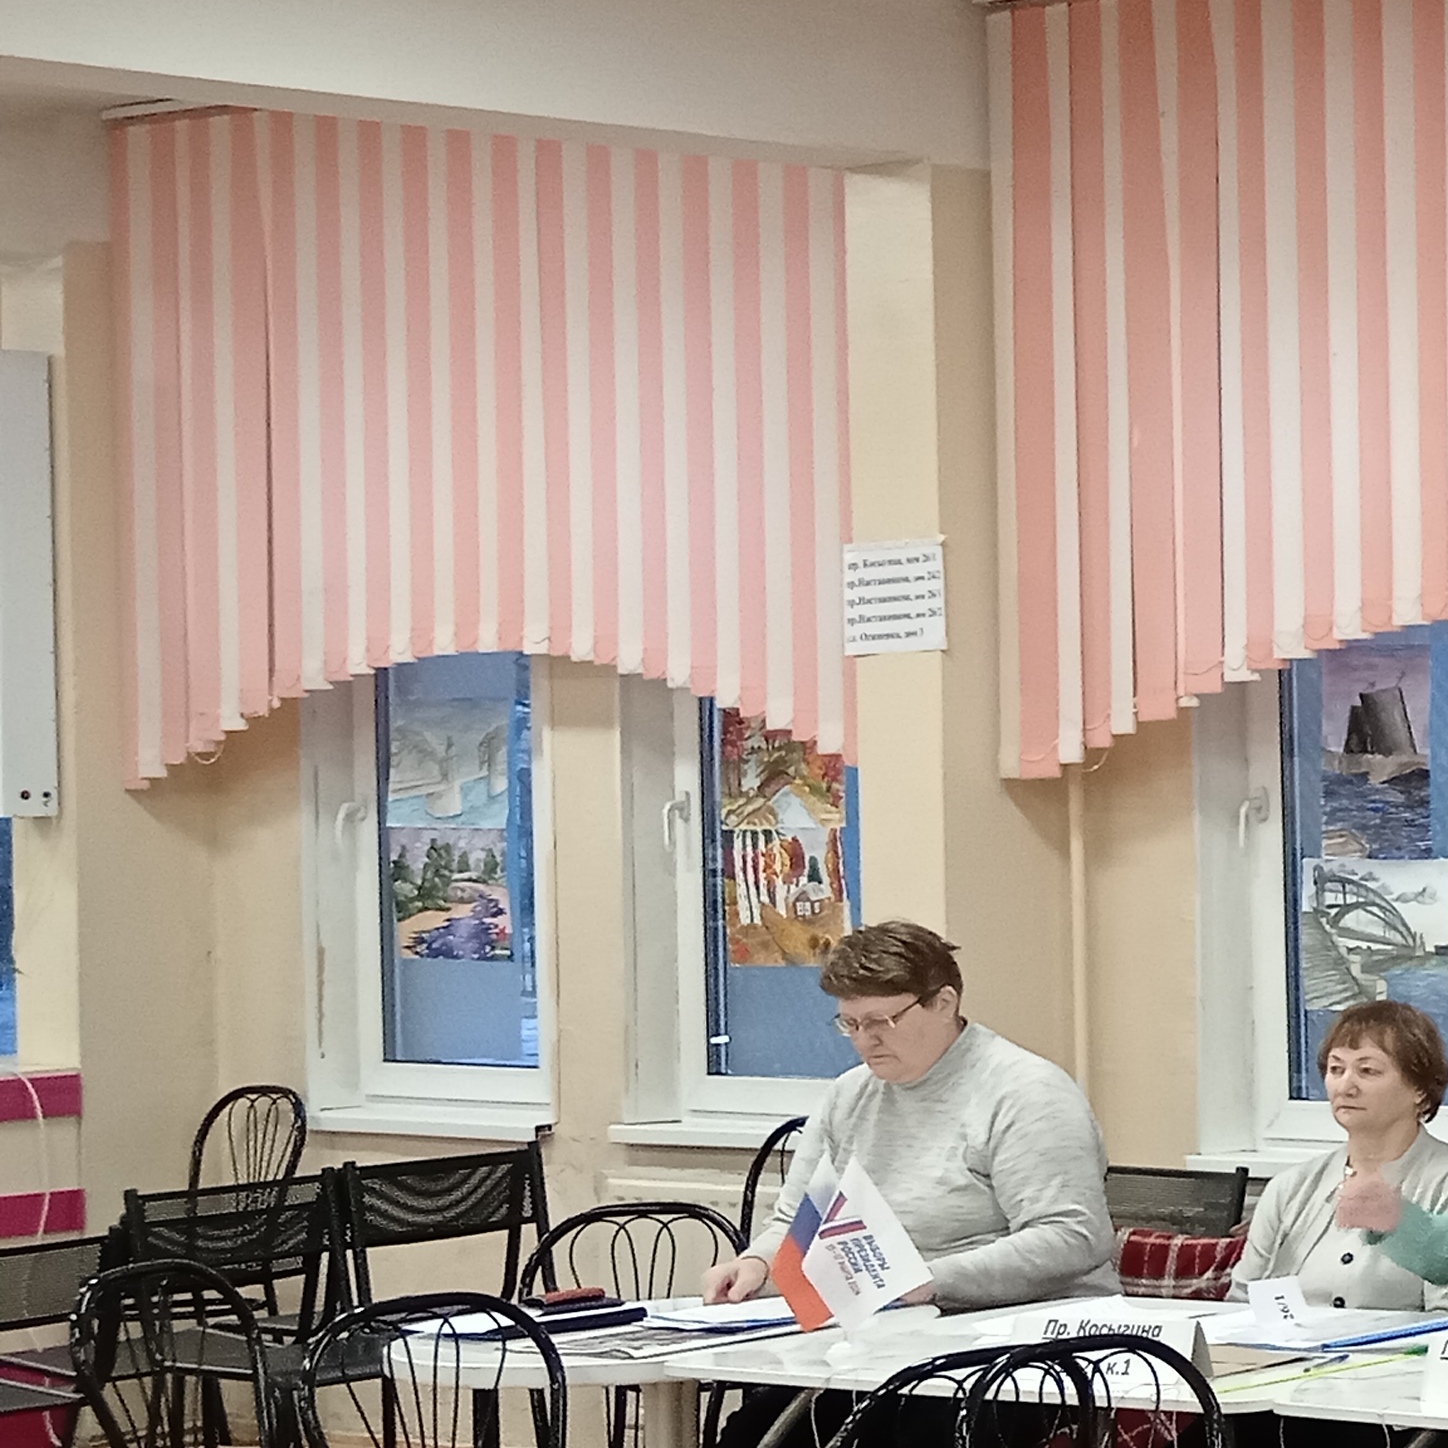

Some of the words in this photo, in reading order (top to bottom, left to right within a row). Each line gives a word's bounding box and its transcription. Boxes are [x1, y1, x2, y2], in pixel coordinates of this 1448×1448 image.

[1043, 1319, 1071, 1339] Пр.
[1076, 1319, 1163, 1338] Косыгина
[1105, 1359, 1131, 1376] к.1
